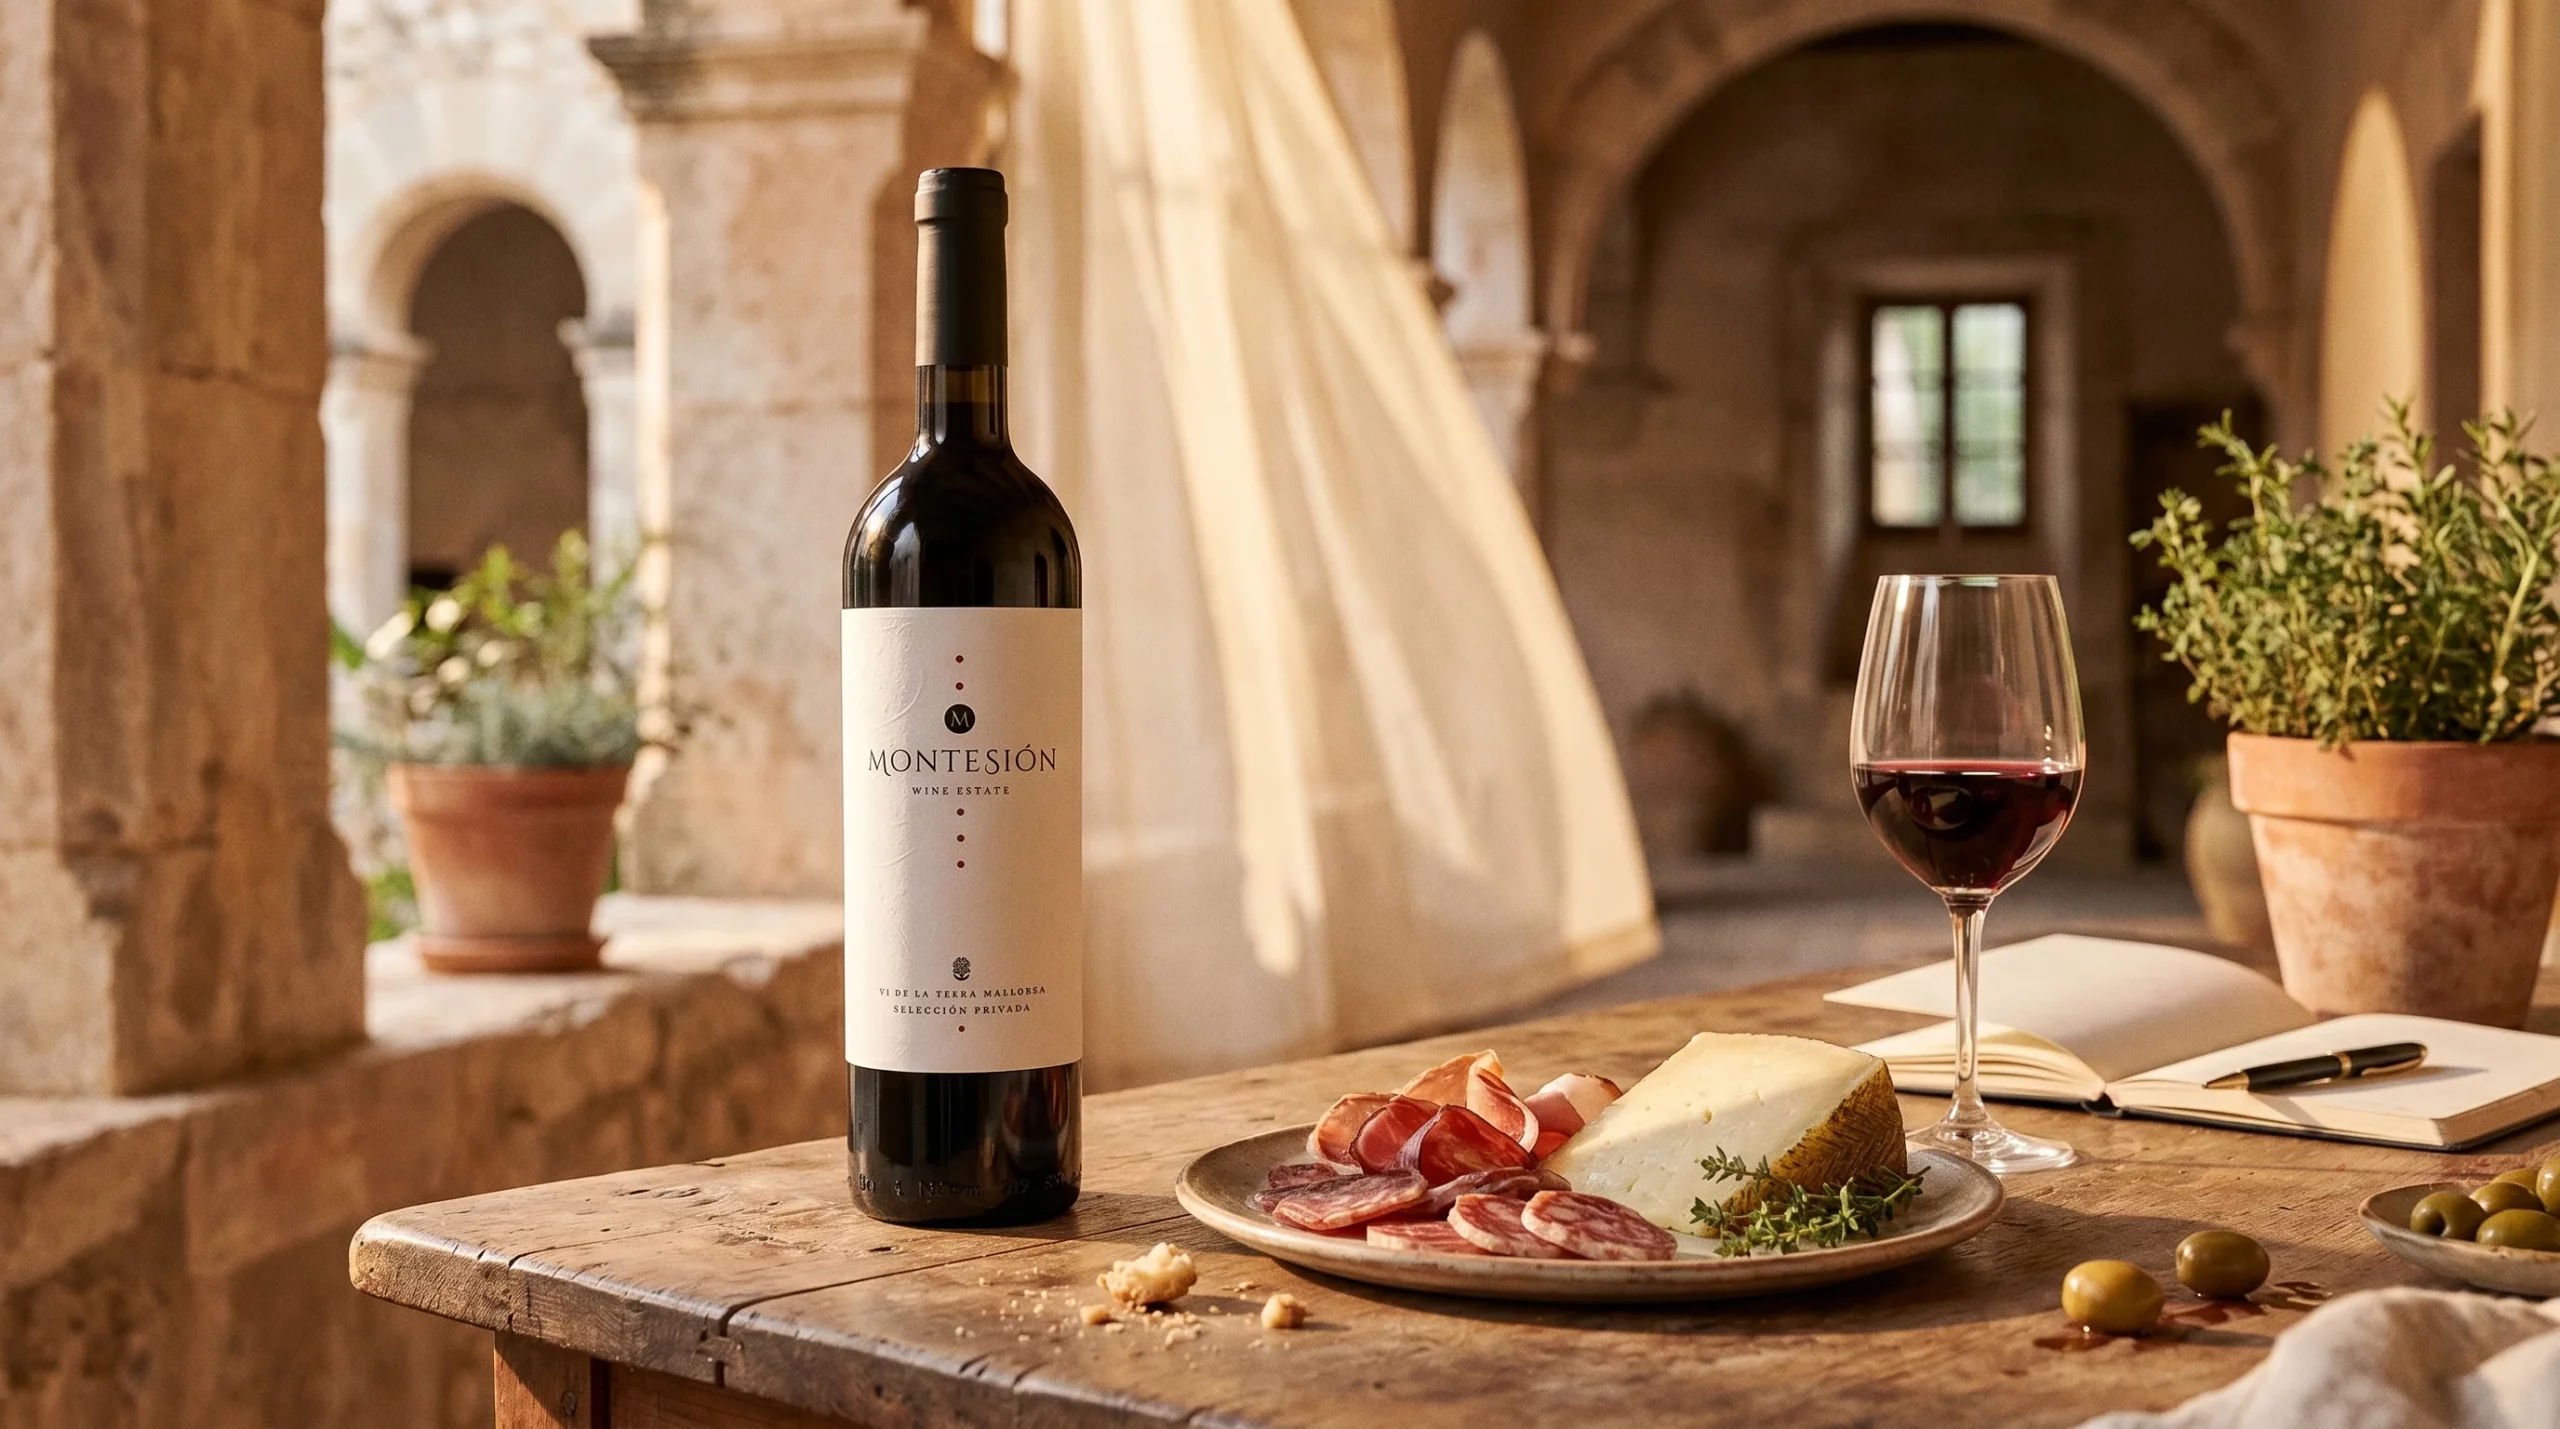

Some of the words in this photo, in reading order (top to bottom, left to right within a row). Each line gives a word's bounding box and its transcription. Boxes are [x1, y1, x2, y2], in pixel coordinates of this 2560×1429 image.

[950, 710, 970, 728] M
[868, 744, 1057, 777] MONTESIÓN
[911, 786, 949, 796] WINE
[956, 786, 1010, 796] ESTATE
[879, 988, 890, 997] VI
[895, 989, 909, 998] DE
[914, 990, 929, 999] LA
[893, 1004, 968, 1015] SELECCIÓN
[974, 1004, 1031, 1015] PRIVADA
